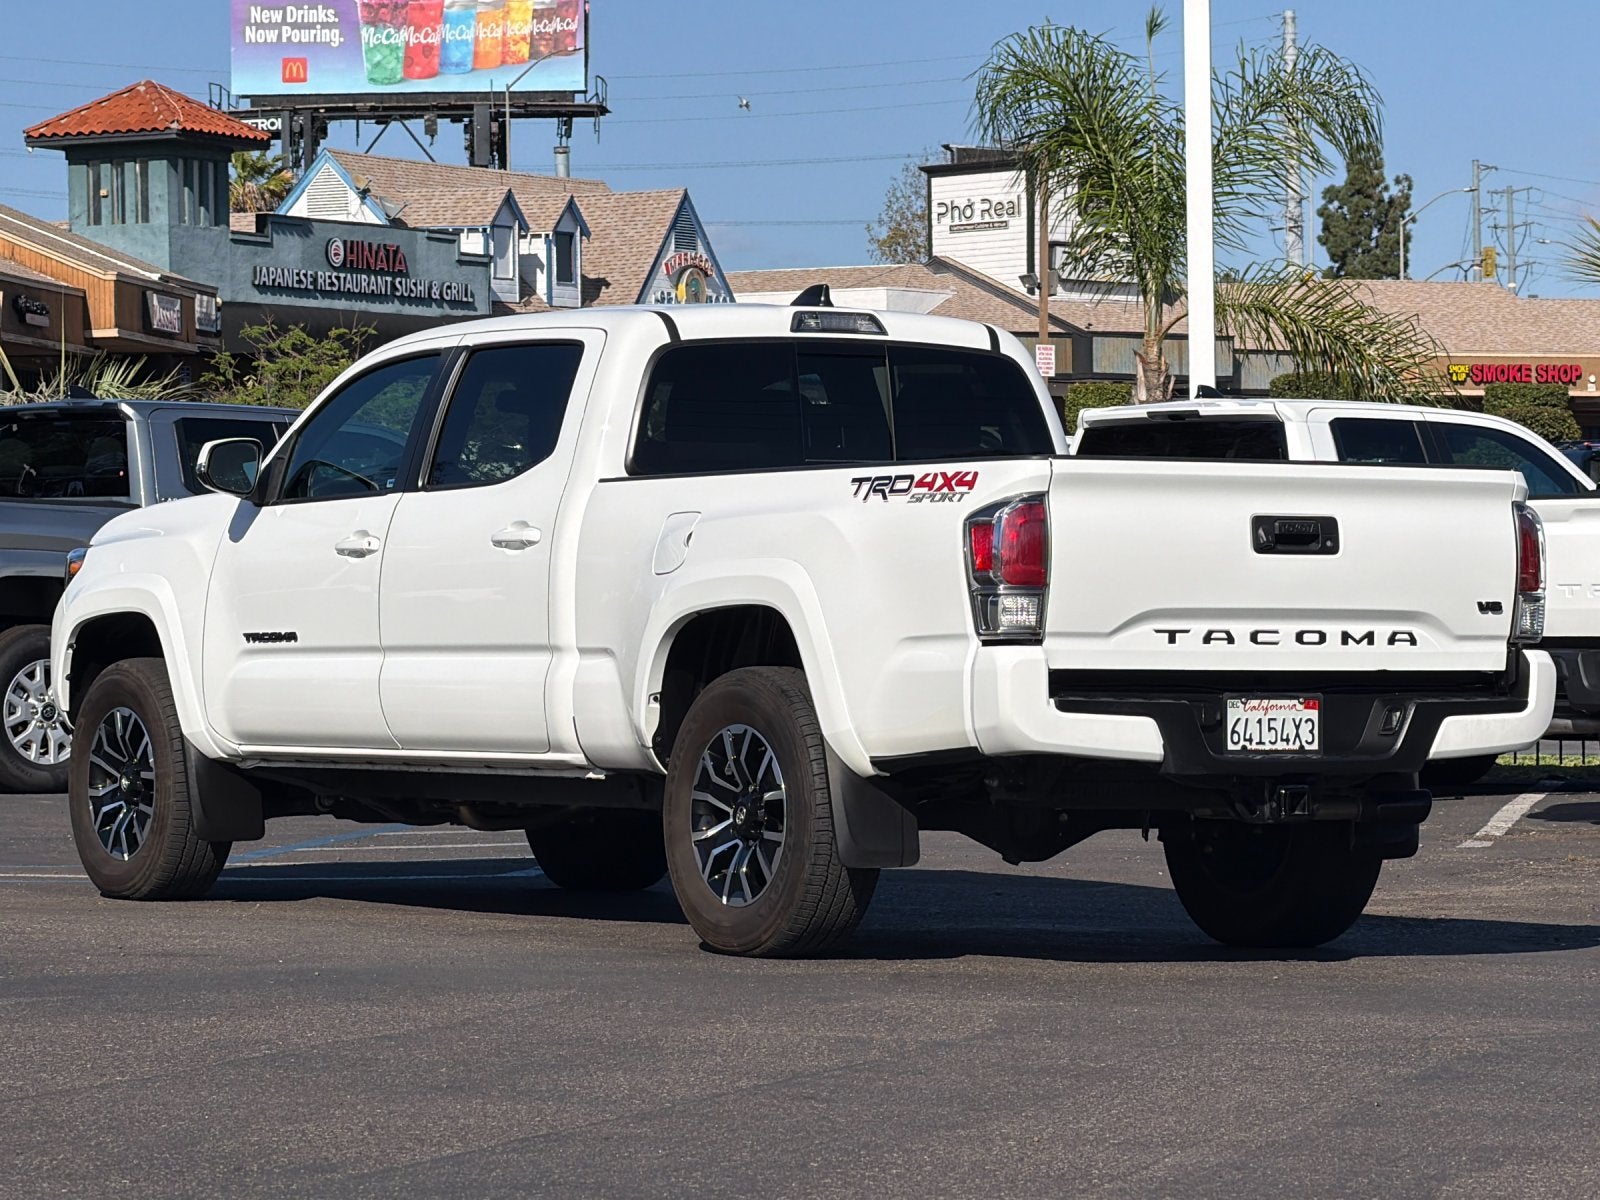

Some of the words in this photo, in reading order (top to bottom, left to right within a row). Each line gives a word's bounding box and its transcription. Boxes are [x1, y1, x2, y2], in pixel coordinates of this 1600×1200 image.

[250, 6, 282, 23] New
[286, 5, 338, 22] Drinks.
[245, 25, 278, 43] Now
[281, 24, 344, 47] Pouring.
[980, 194, 1021, 219] Real
[346, 239, 407, 273] HINATA
[254, 265, 314, 290] JAPANESE
[317, 270, 393, 296] RESTAURANT
[395, 277, 428, 299] SUSHI
[431, 280, 440, 300] &
[443, 281, 474, 302] GRILL
[1448, 364, 1470, 373] SMOKE
[1458, 373, 1466, 381] UP
[1471, 364, 1532, 382] SMOKE
[1536, 364, 1582, 382] SHOP
[850, 474, 915, 503] TRD
[907, 491, 970, 504] SPORT
[1477, 601, 1503, 615] V6
[1154, 629, 1418, 646] TACOMA
[1228, 700, 1240, 709] DEC
[1243, 699, 1302, 716] California
[1230, 717, 1315, 746] 64154X3
